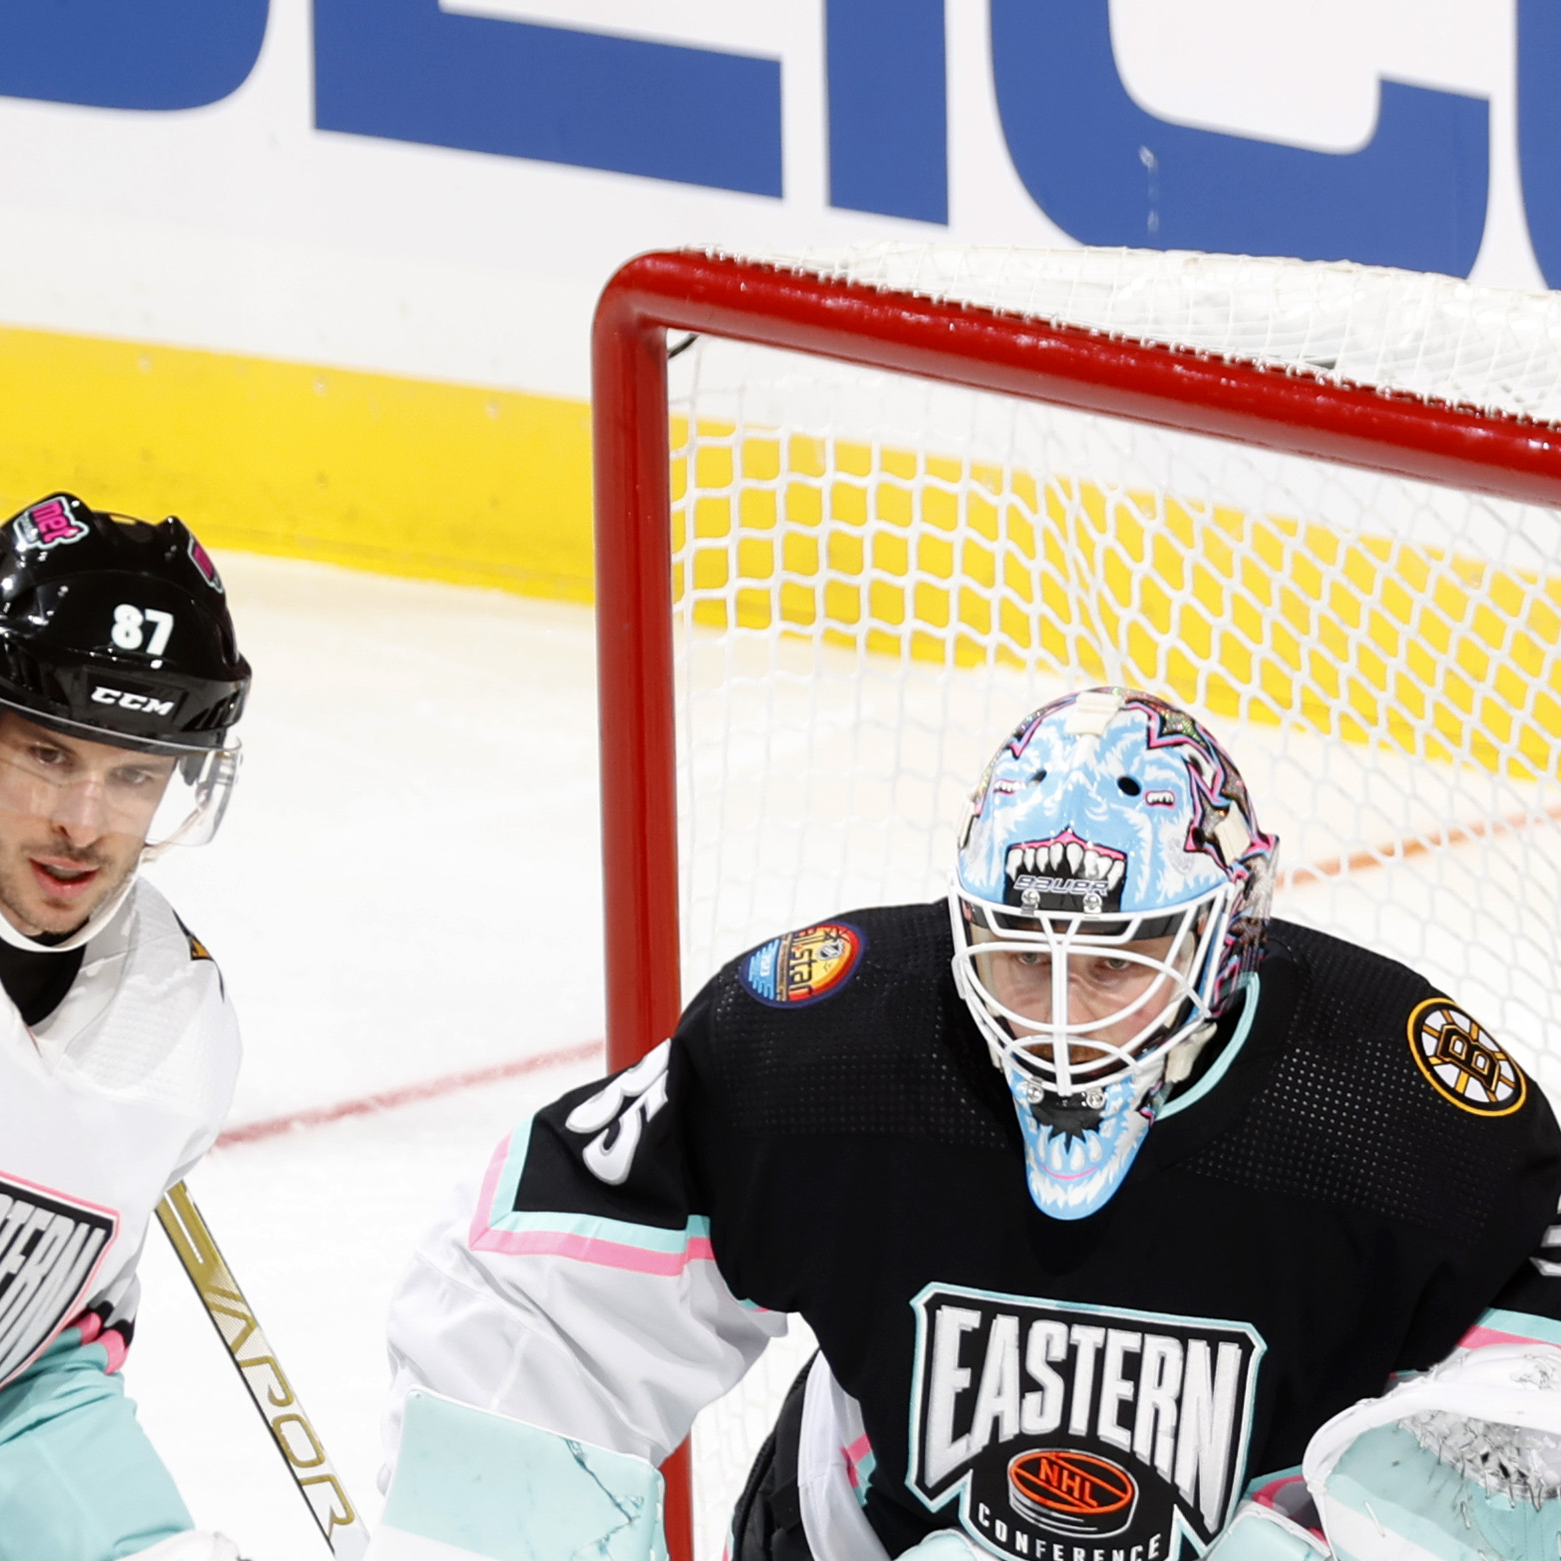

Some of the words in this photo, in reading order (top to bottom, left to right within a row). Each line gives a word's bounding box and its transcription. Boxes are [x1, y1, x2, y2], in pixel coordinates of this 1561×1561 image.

[111, 604, 174, 656] 87
[91, 686, 174, 716] CCM
[925, 1305, 1242, 1535] EASTERN
[1039, 1458, 1099, 1508] NHL
